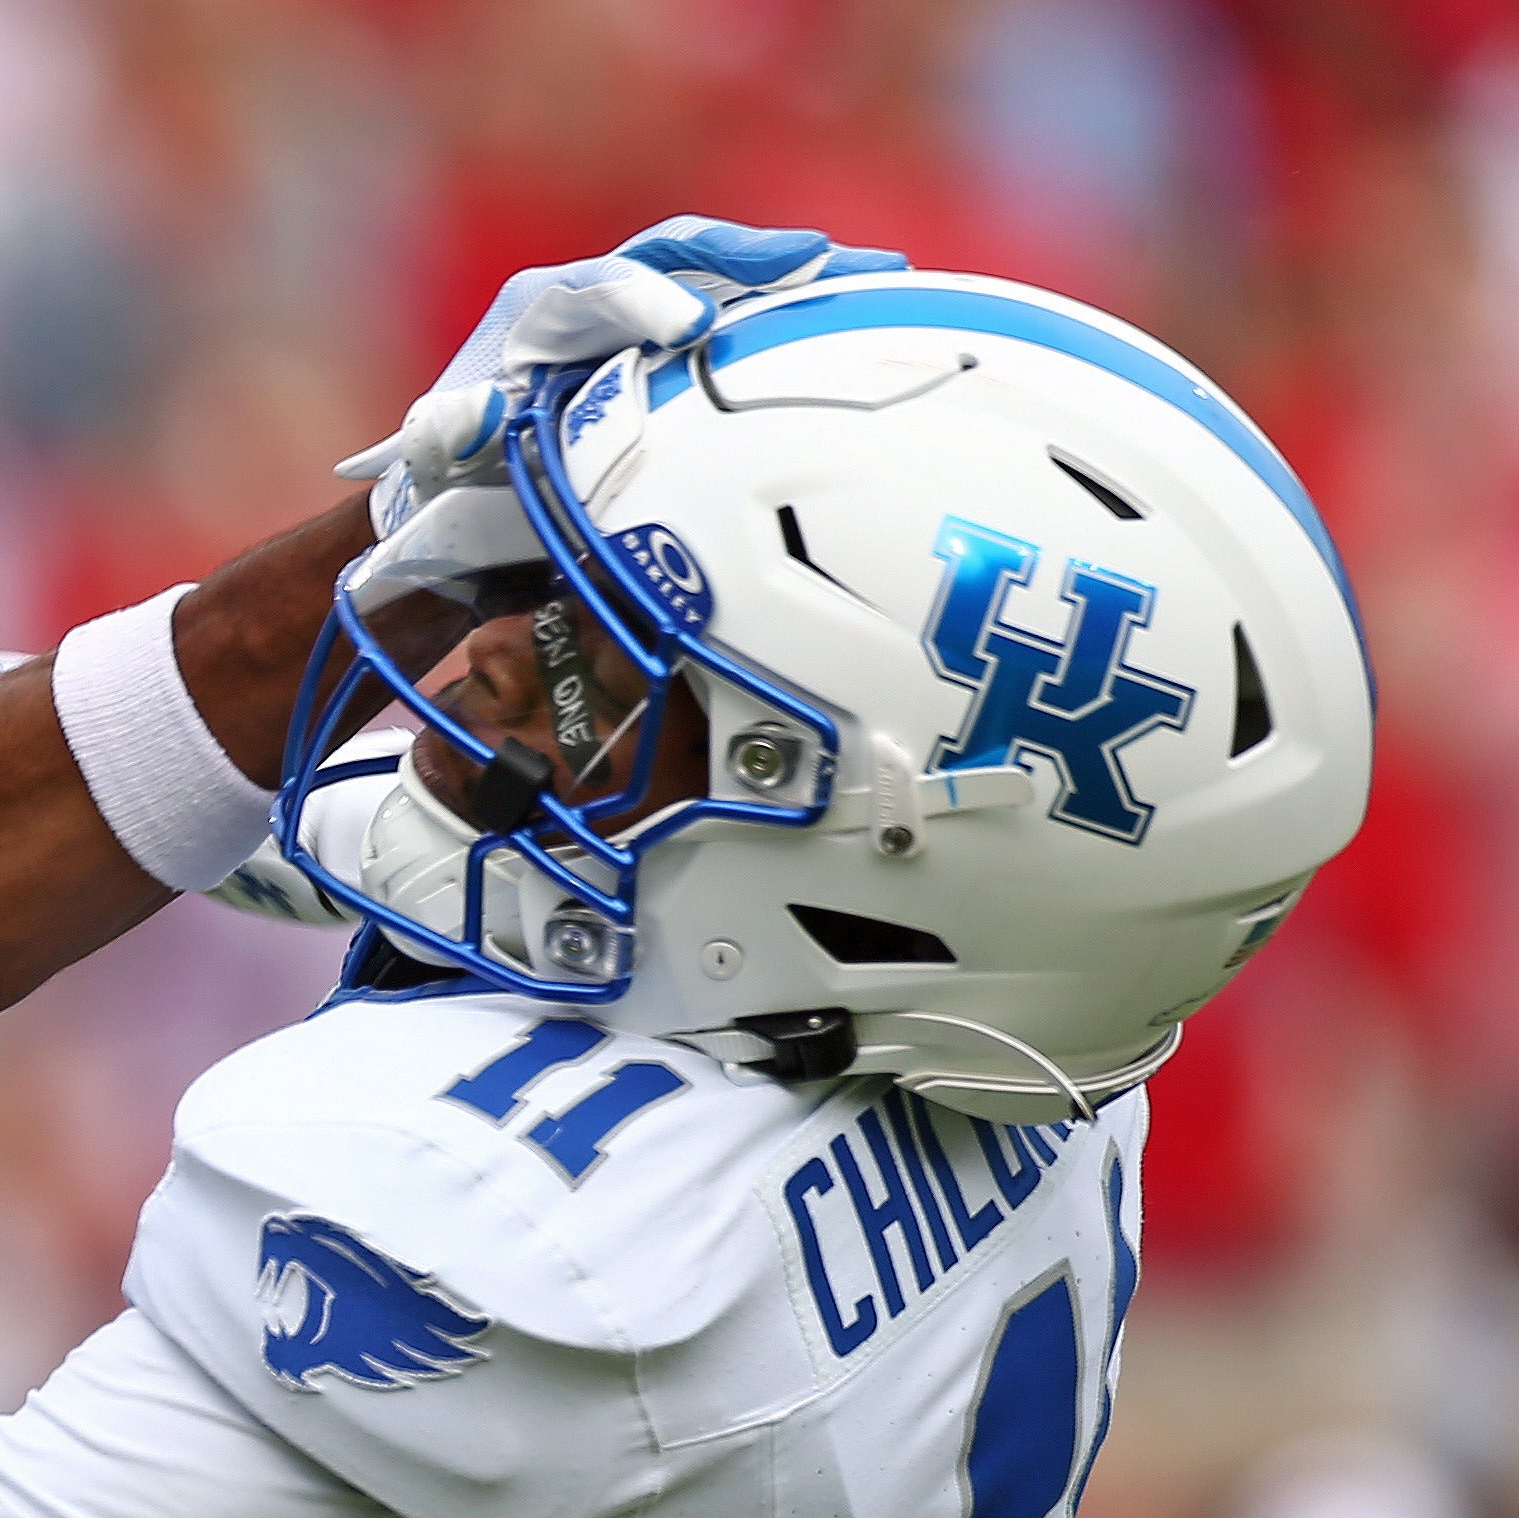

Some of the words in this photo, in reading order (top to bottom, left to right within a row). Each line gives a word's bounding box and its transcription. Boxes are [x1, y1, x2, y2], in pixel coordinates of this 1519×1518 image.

[620, 532, 703, 624] OAKLEY
[433, 1016, 694, 1193] 11
[783, 1086, 1075, 1360] CHILD
